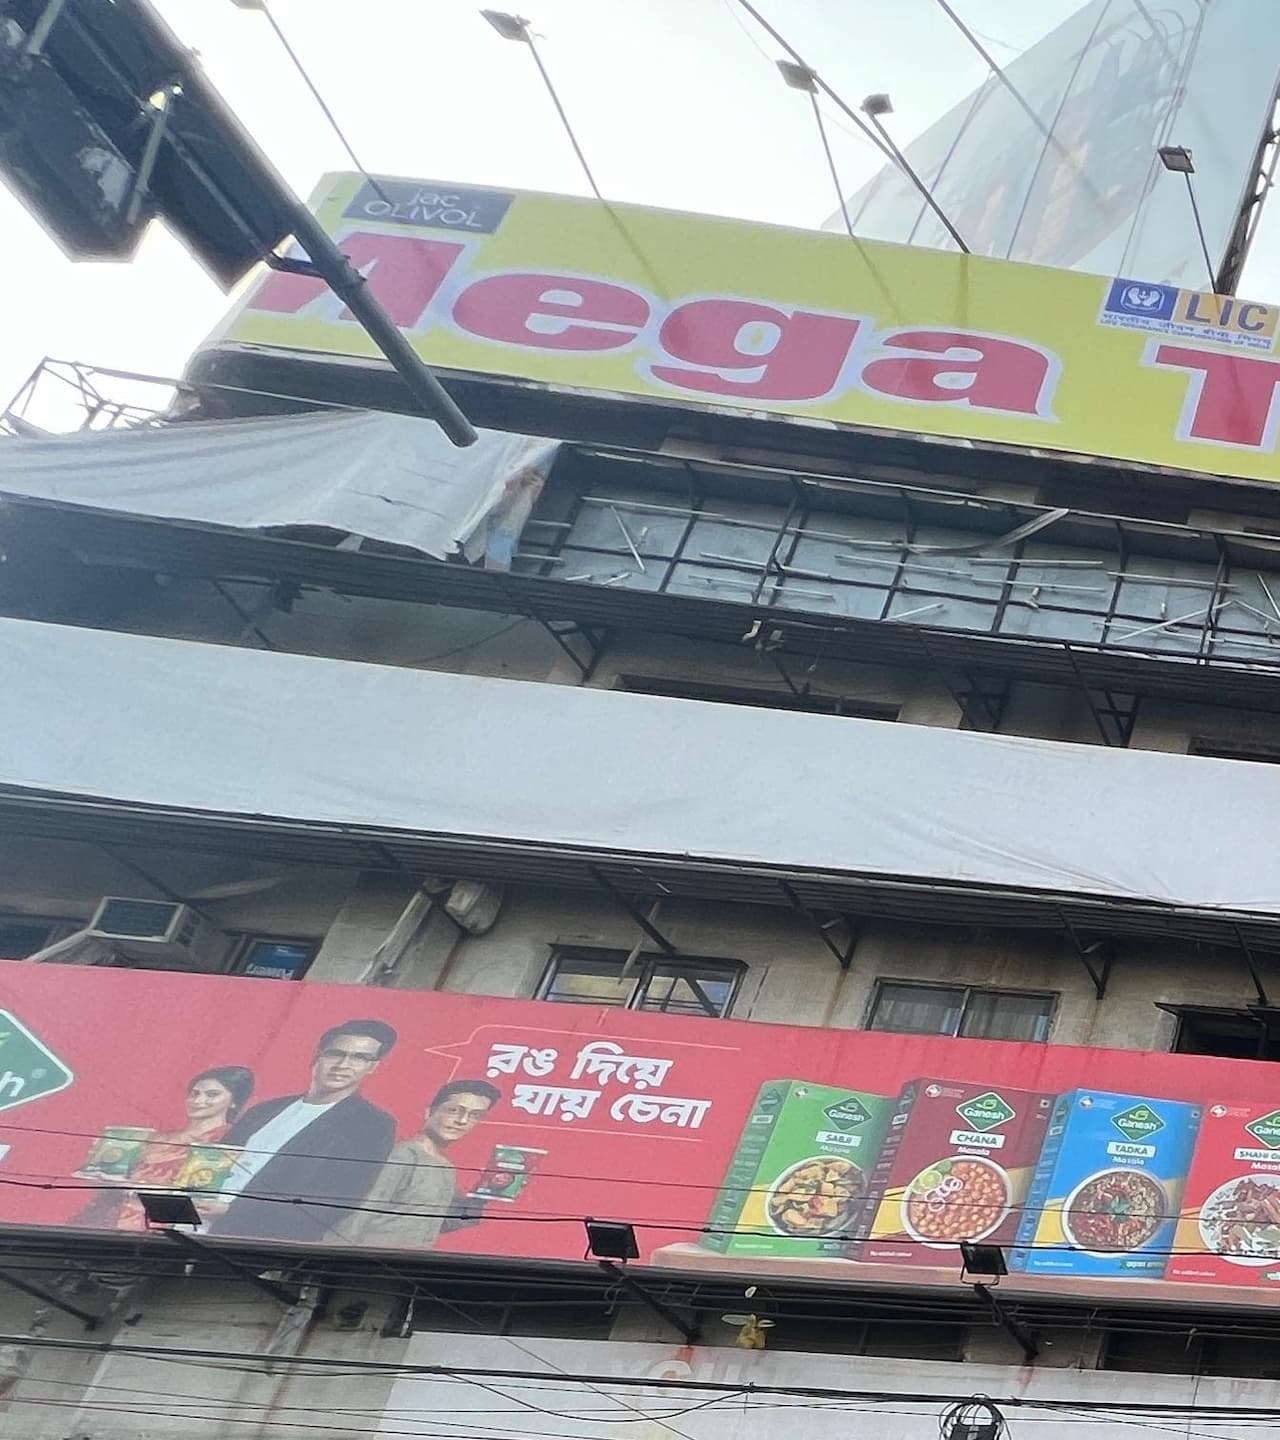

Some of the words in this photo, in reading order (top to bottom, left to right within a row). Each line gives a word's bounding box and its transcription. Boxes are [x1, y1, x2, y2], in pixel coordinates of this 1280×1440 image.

[408, 188, 460, 208] jac
[363, 200, 482, 228] OLIVOL
[1185, 294, 1268, 331] LIC
[486, 1043, 558, 1078] রঙ
[569, 1041, 674, 1090] দিয়ে
[511, 1083, 602, 1123] যায়
[610, 1093, 713, 1129] চেনা
[963, 1106, 1004, 1120] Ganesh
[828, 1108, 865, 1122] Ganesh
[1117, 1118, 1156, 1131] Ganesh
[956, 1133, 999, 1146] CHANA
[1114, 1144, 1149, 1155] TADKA
